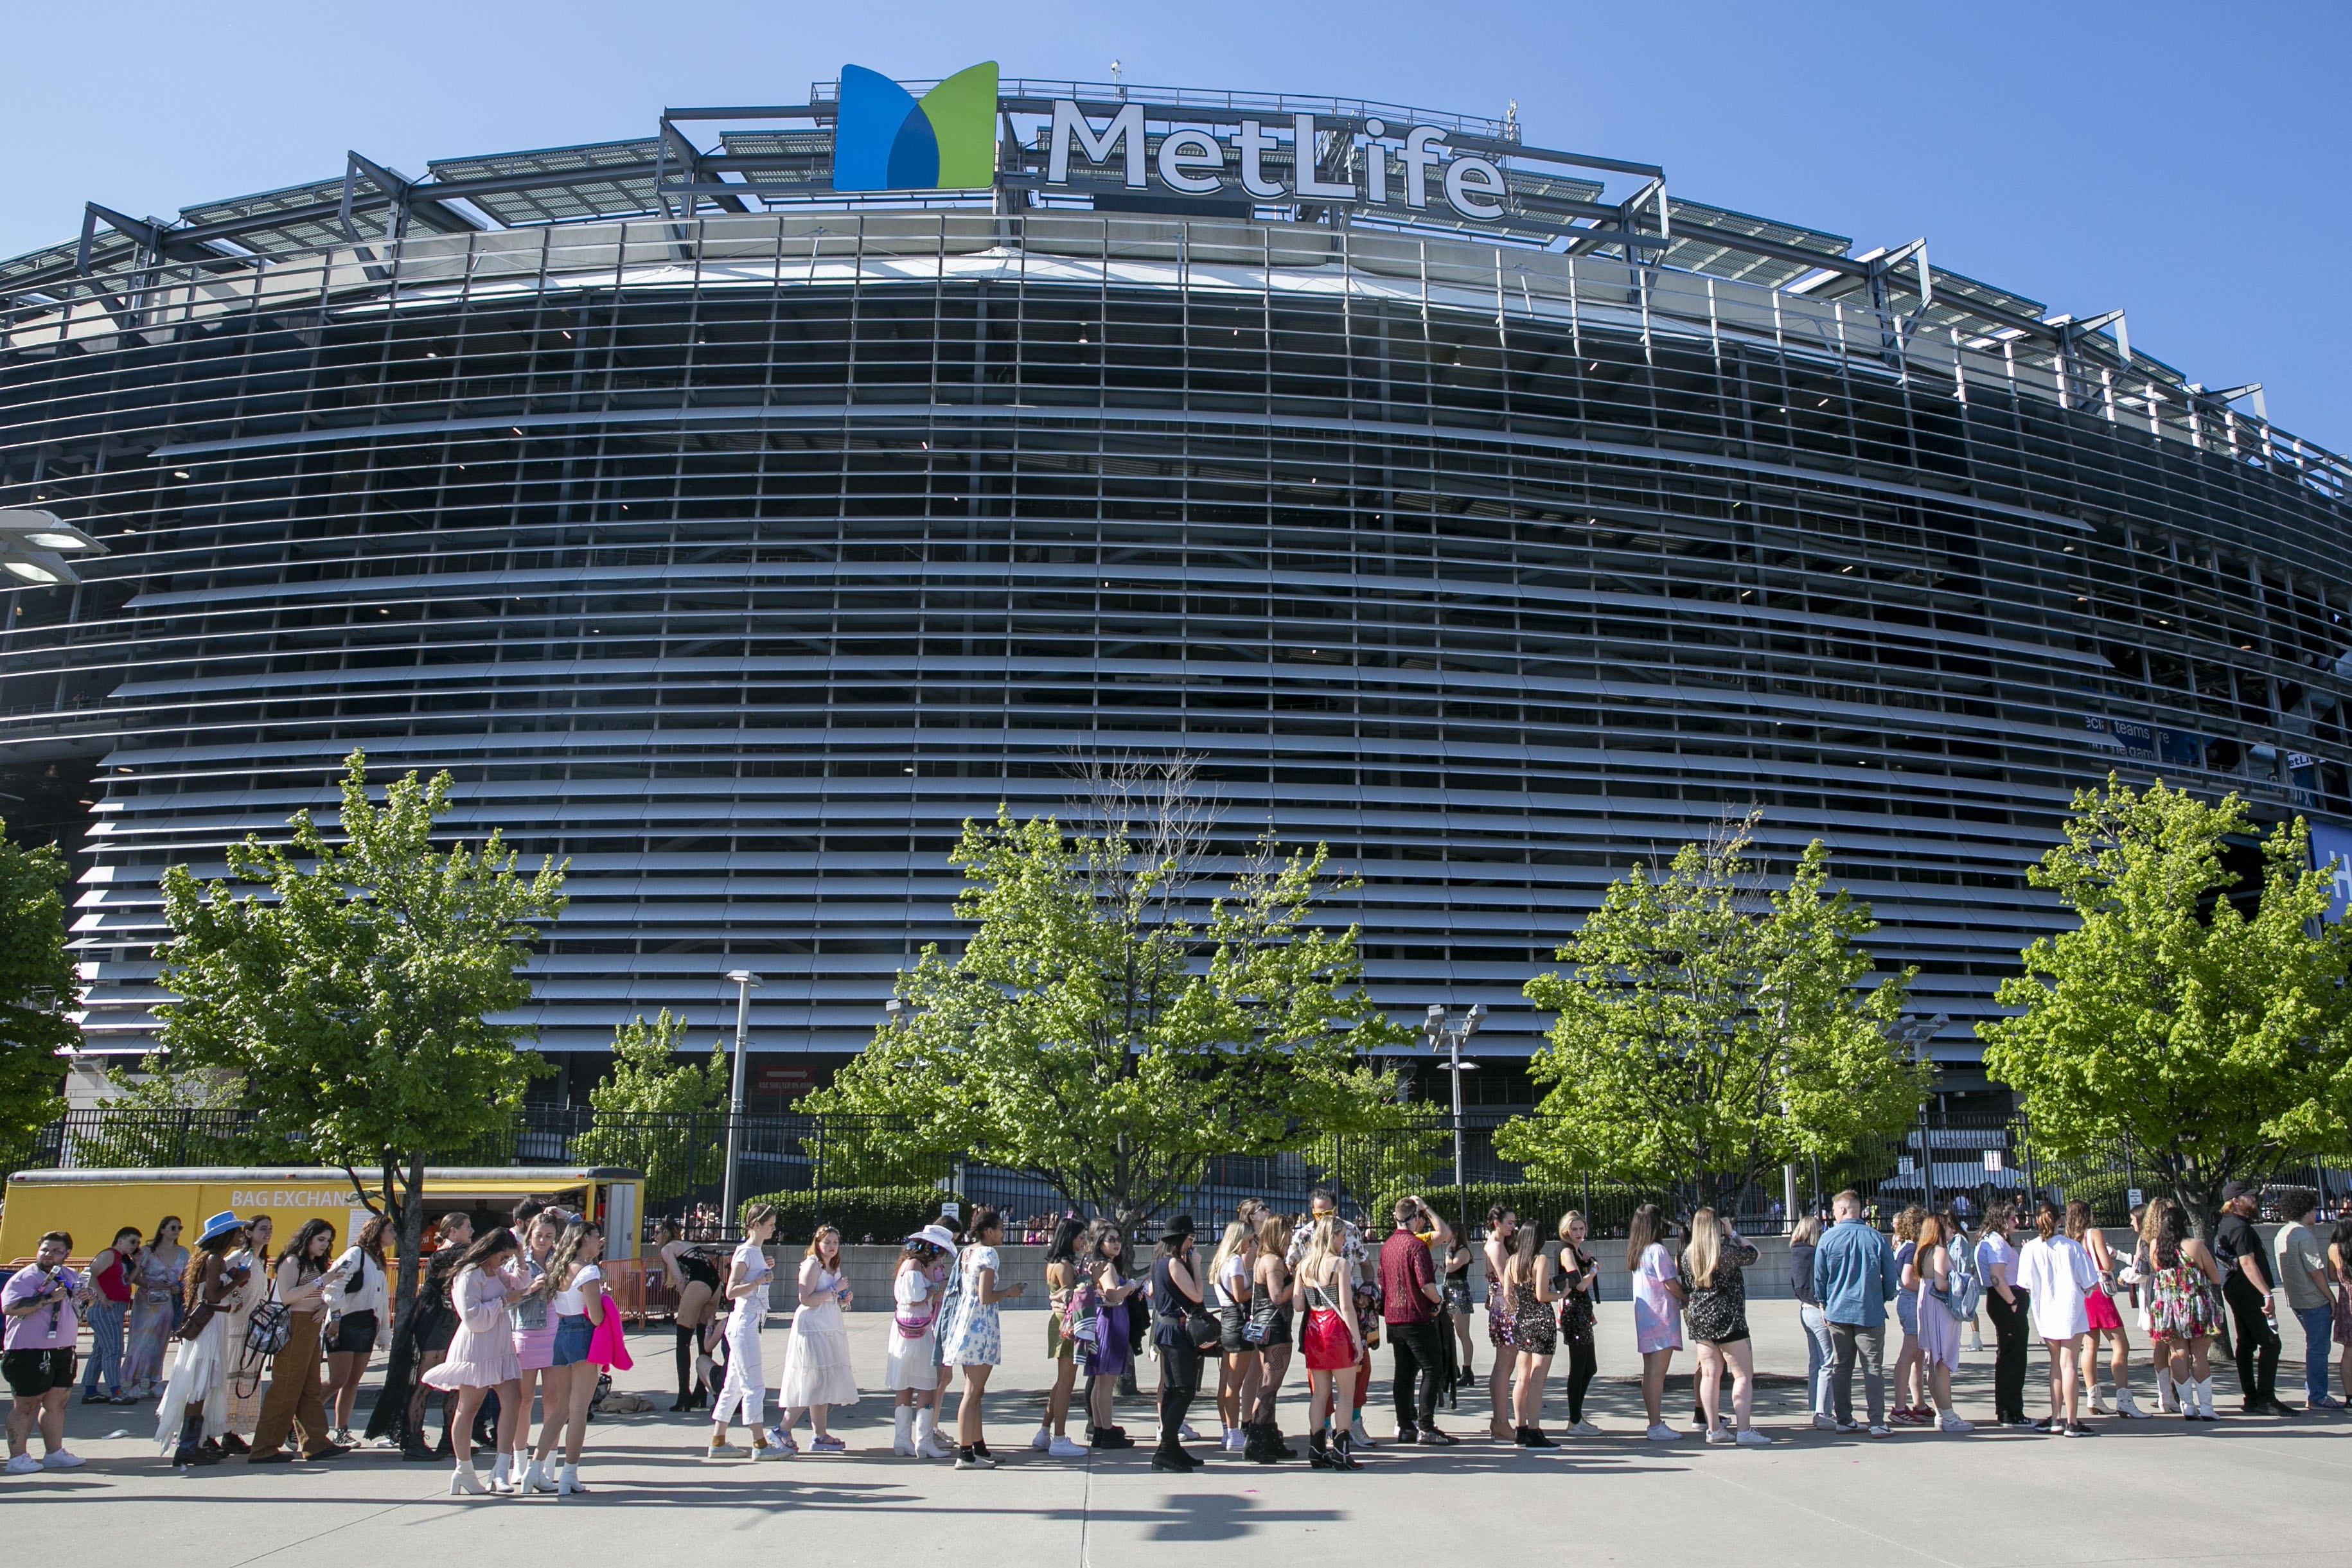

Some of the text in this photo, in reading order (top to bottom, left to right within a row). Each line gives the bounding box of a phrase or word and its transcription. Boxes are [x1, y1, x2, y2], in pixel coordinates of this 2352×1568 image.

[1045, 98, 1507, 220] MetLife
[2114, 720, 2150, 739] teams
[2159, 731, 2170, 744] re
[231, 1190, 364, 1207] BAG EXCHANG
